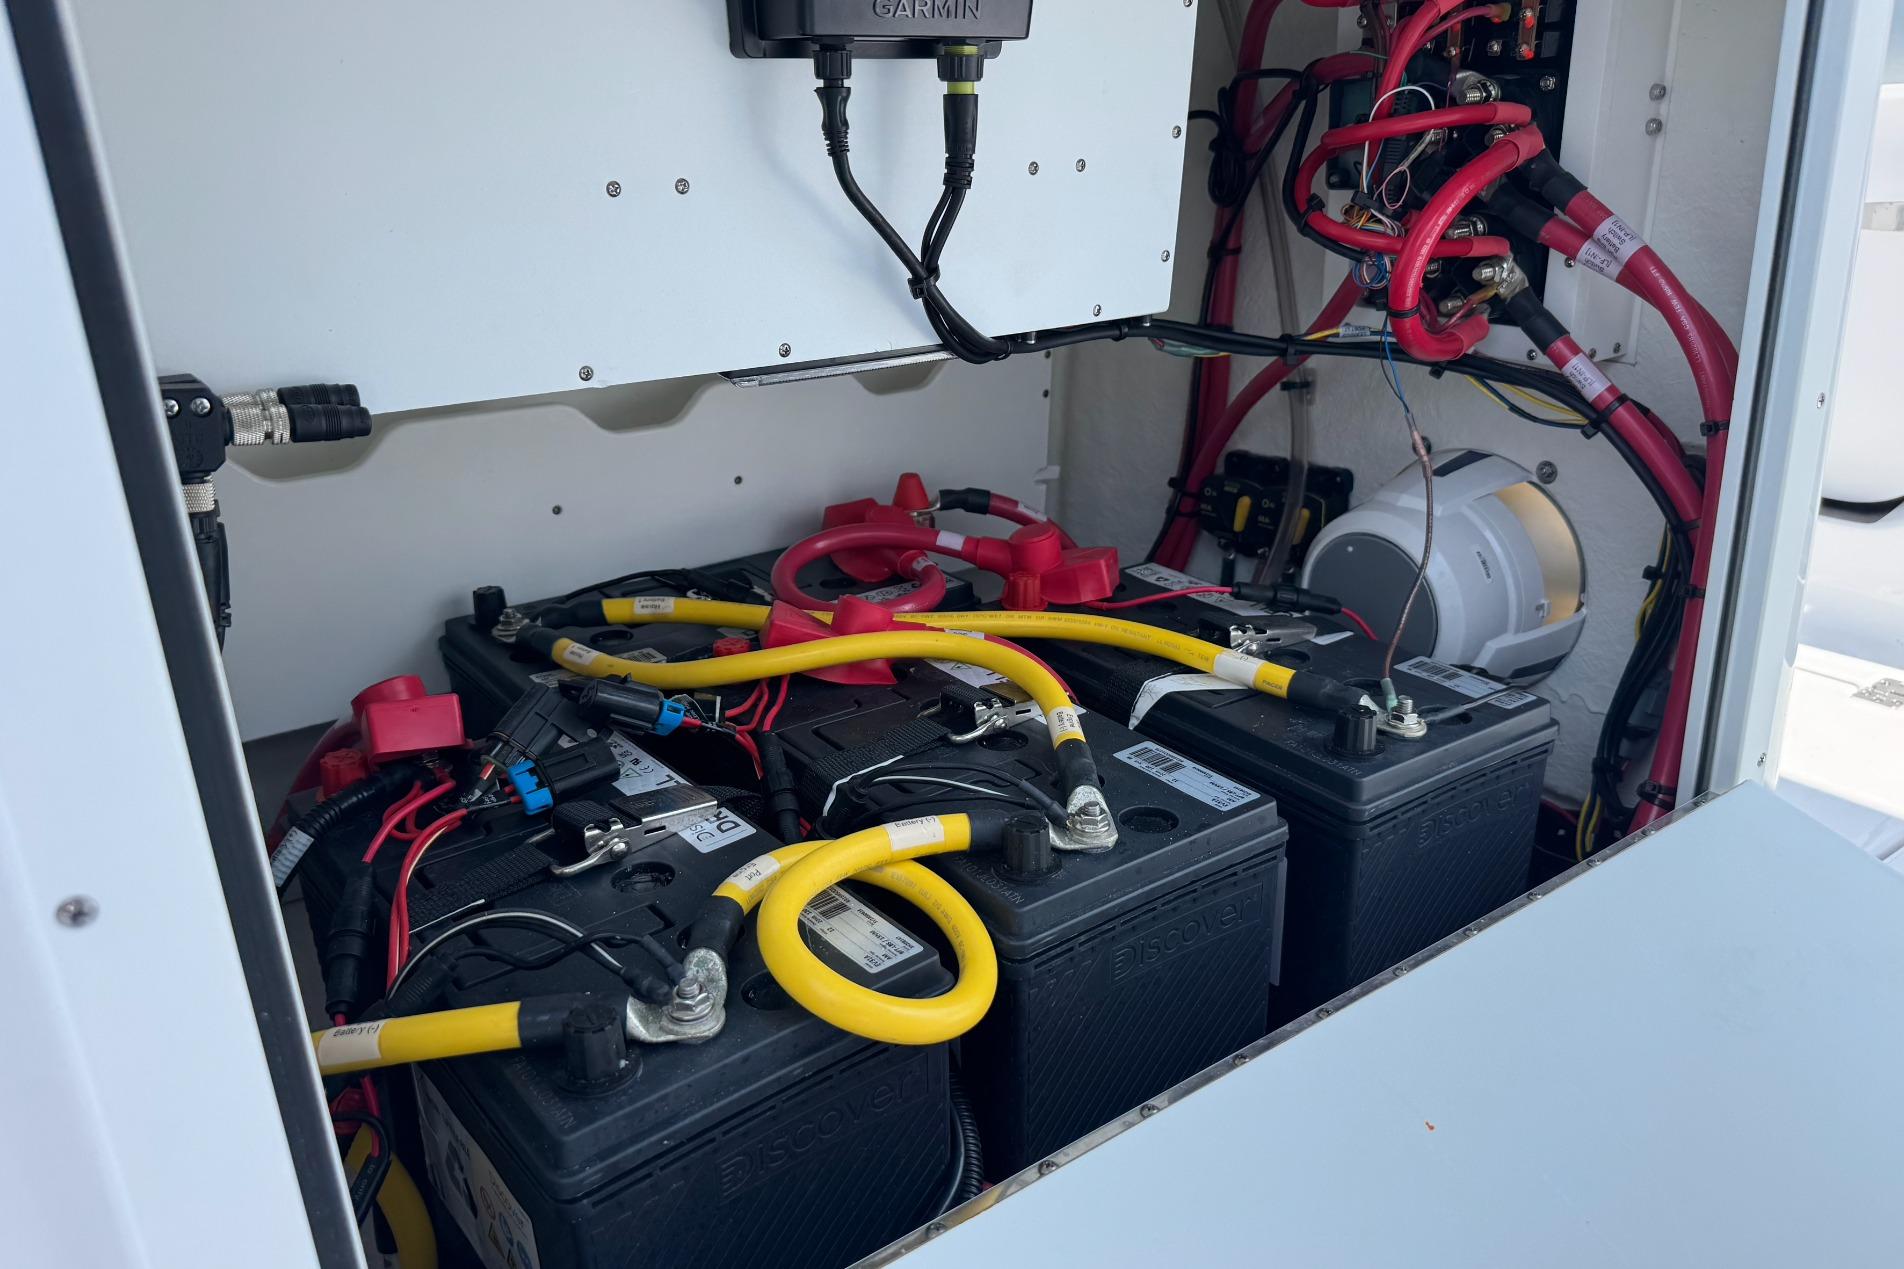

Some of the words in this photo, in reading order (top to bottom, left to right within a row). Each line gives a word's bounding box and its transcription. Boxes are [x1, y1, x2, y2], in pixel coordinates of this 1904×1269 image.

[872, 0, 980, 19] GARMIN
[1607, 227, 1626, 246] Switch
[1113, 897, 1250, 981] Discover
